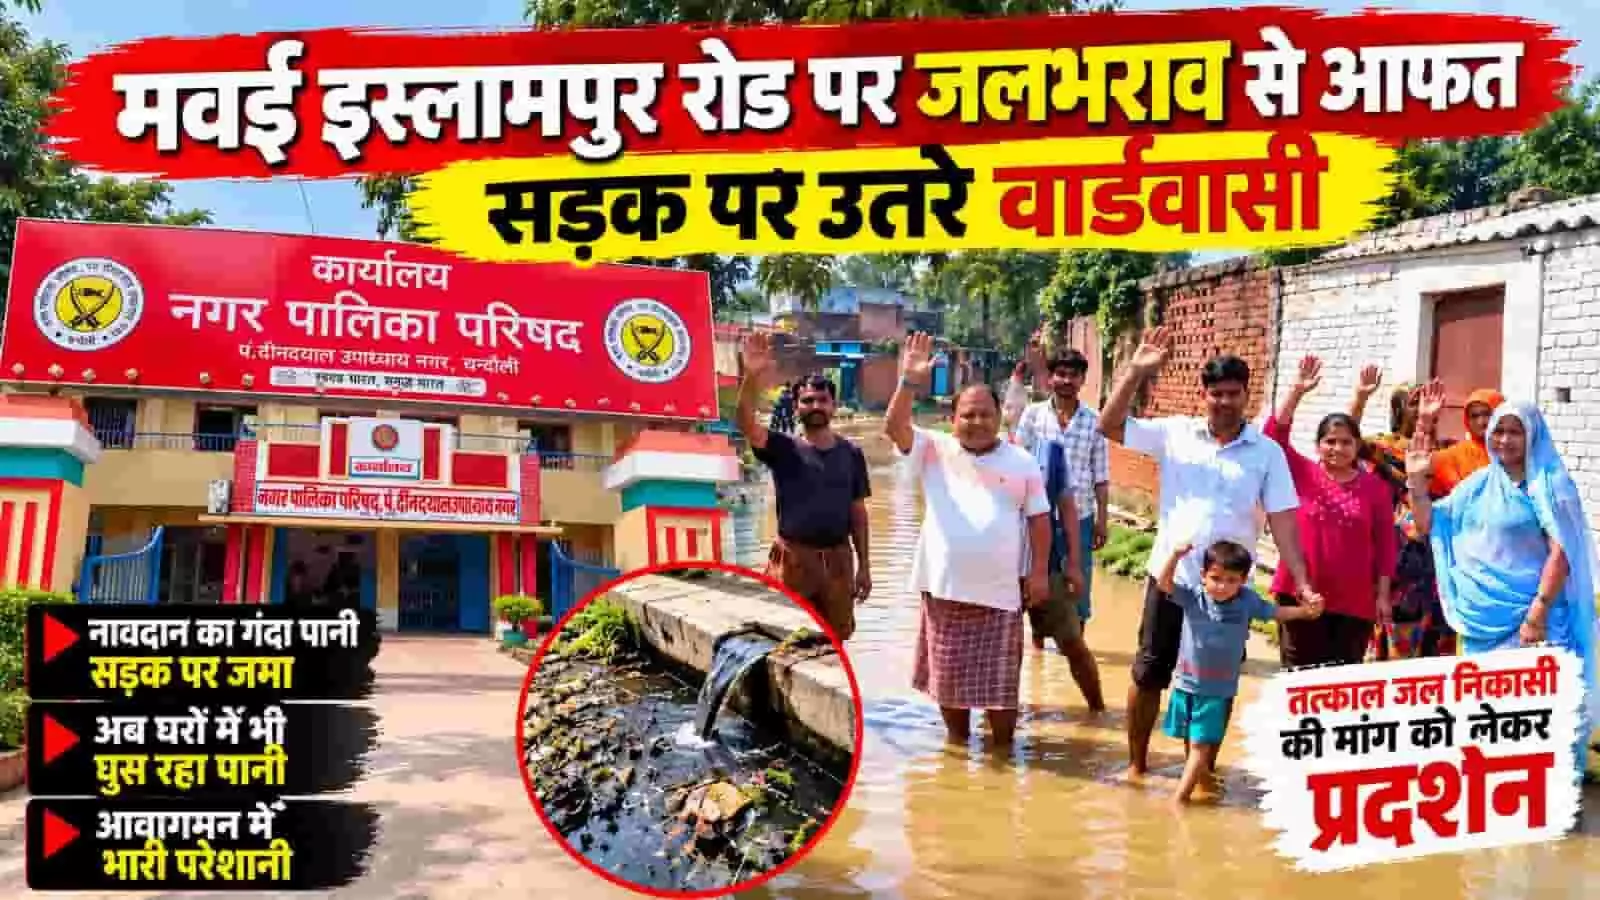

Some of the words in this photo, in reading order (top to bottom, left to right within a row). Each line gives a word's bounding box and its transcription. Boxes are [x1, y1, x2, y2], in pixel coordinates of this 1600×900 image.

[311, 250, 453, 290] कार्यालय
[167, 294, 268, 332] नगर
[285, 290, 439, 343] पालिका
[455, 302, 583, 353] परिषद
